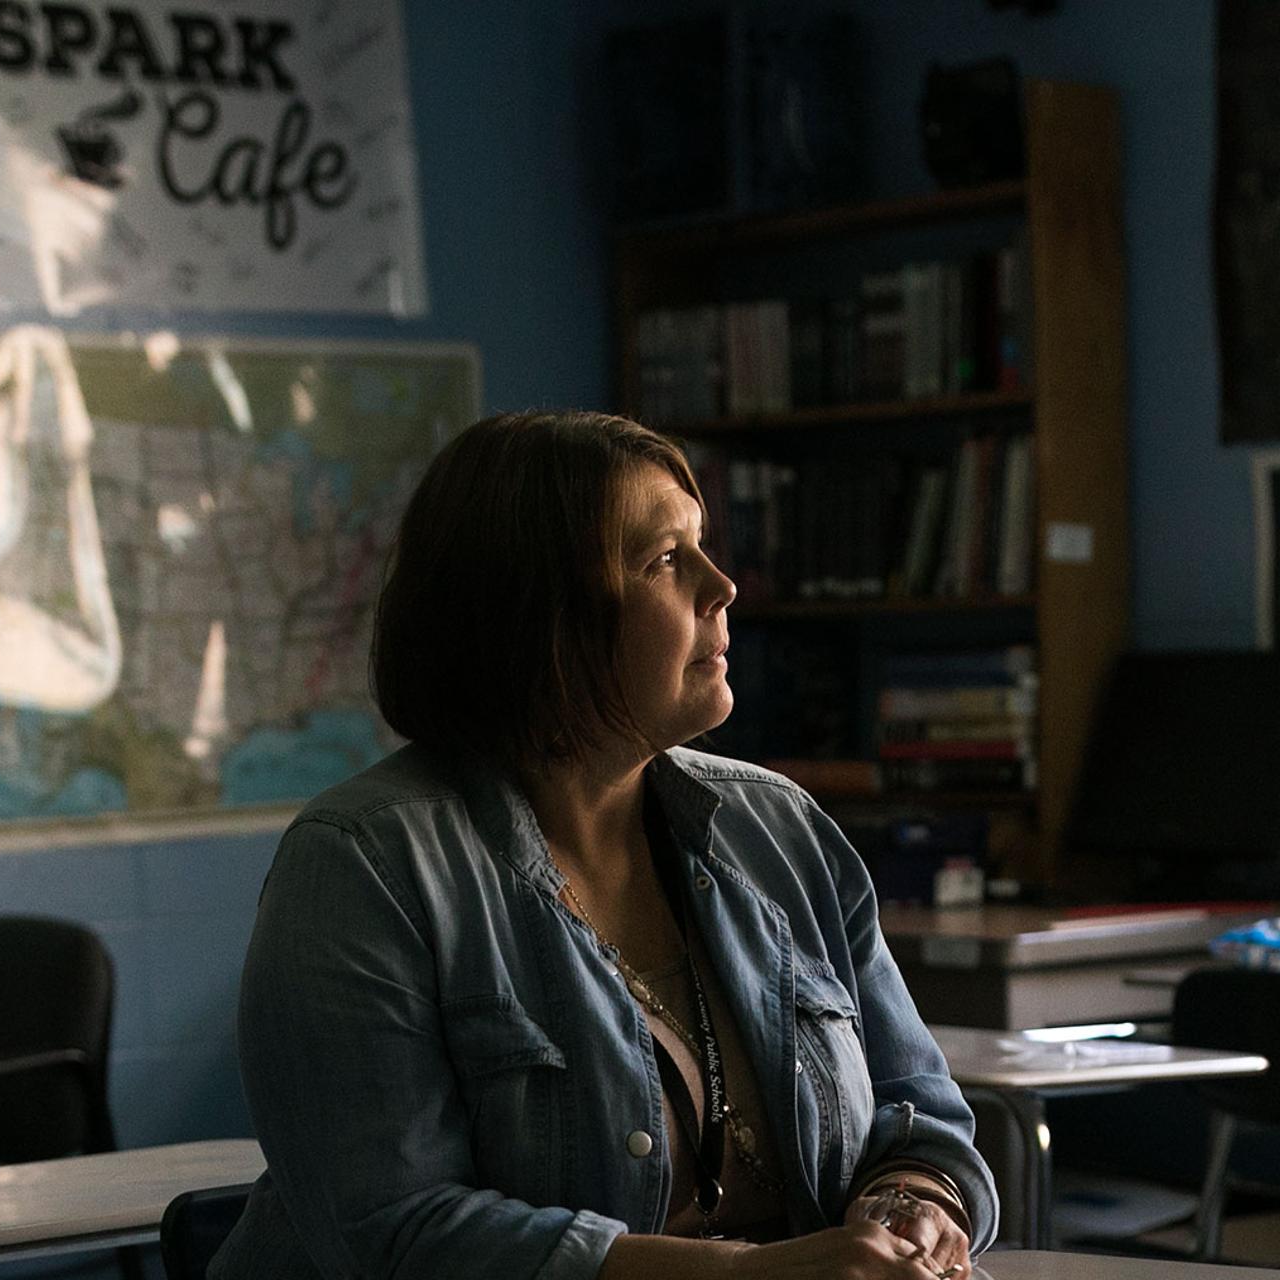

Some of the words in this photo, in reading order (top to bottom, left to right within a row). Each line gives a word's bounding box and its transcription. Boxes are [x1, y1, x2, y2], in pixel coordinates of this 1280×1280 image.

[161, 93, 356, 250] Cafe
[704, 1035, 720, 1073] Public
[709, 1074, 725, 1124] Schools
